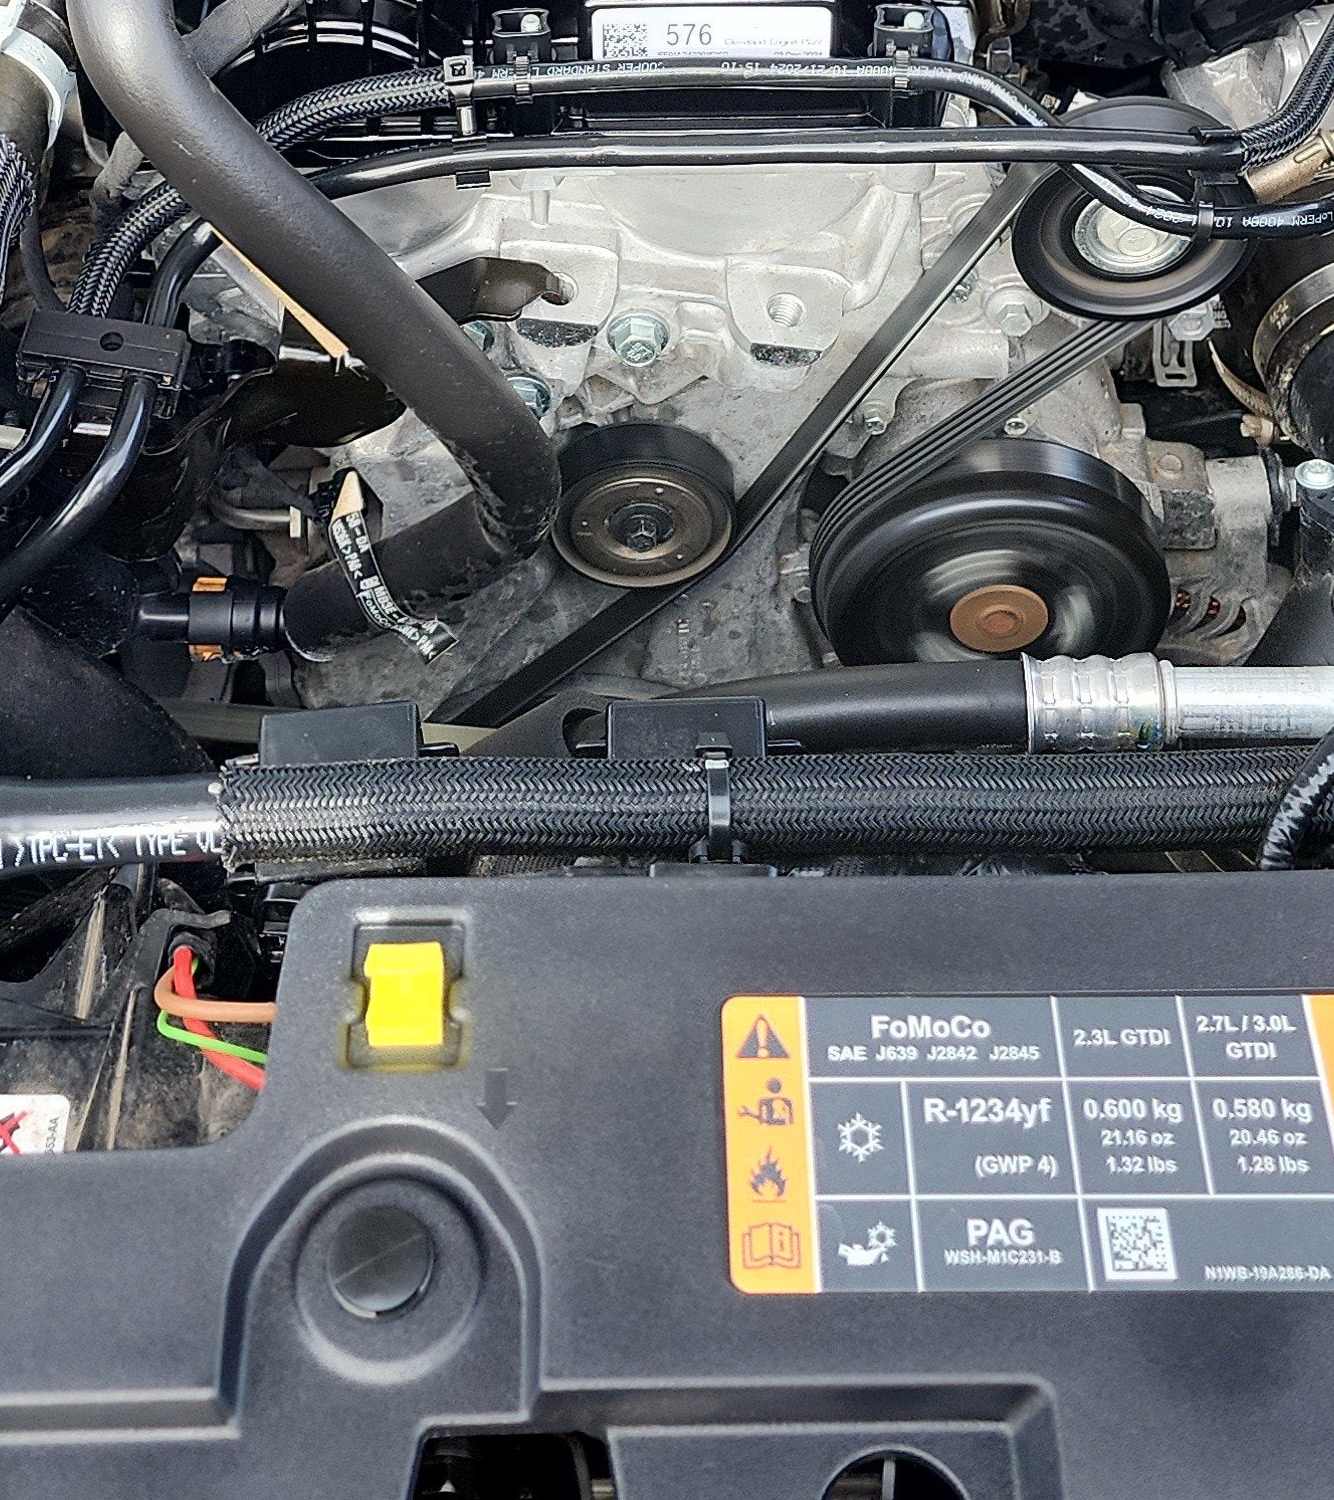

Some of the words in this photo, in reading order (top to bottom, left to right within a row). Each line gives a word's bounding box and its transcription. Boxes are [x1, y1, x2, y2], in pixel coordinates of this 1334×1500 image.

[666, 23, 712, 46] 576
[546, 63, 611, 78] STANDARD
[870, 1014, 992, 1039] FoMoCo
[1195, 1014, 1238, 1033] 2.7L
[1252, 1014, 1297, 1033] 3.0L
[1072, 1028, 1118, 1047] 2.3L
[1120, 1028, 1172, 1046] GTDI
[827, 1045, 868, 1062] SAE
[875, 1045, 918, 1062] J639
[926, 1045, 978, 1062] J2842
[989, 1045, 1041, 1062] J2845
[1225, 1041, 1278, 1059] GTDI
[923, 1097, 1053, 1130] R-1234yf
[1083, 1098, 1147, 1119] 0.600
[1152, 1097, 1184, 1124] kg
[1212, 1098, 1276, 1119] 0.580
[1280, 1097, 1313, 1124] kg
[1100, 1129, 1149, 1147] 21.16
[1151, 1131, 1176, 1147] oz
[1229, 1129, 1279, 1147] 20.46
[1283, 1131, 1308, 1147] oz
[974, 1154, 1035, 1179] (GWP
[1036, 1154, 1059, 1180] 4)
[1105, 1155, 1146, 1173] 1.32
[1147, 1155, 1179, 1173] lbs
[1236, 1155, 1277, 1173] 1.28
[1278, 1155, 1311, 1173] lbs
[966, 1217, 1036, 1247] PAG
[944, 1248, 1063, 1266] WSH-M1C231-B
